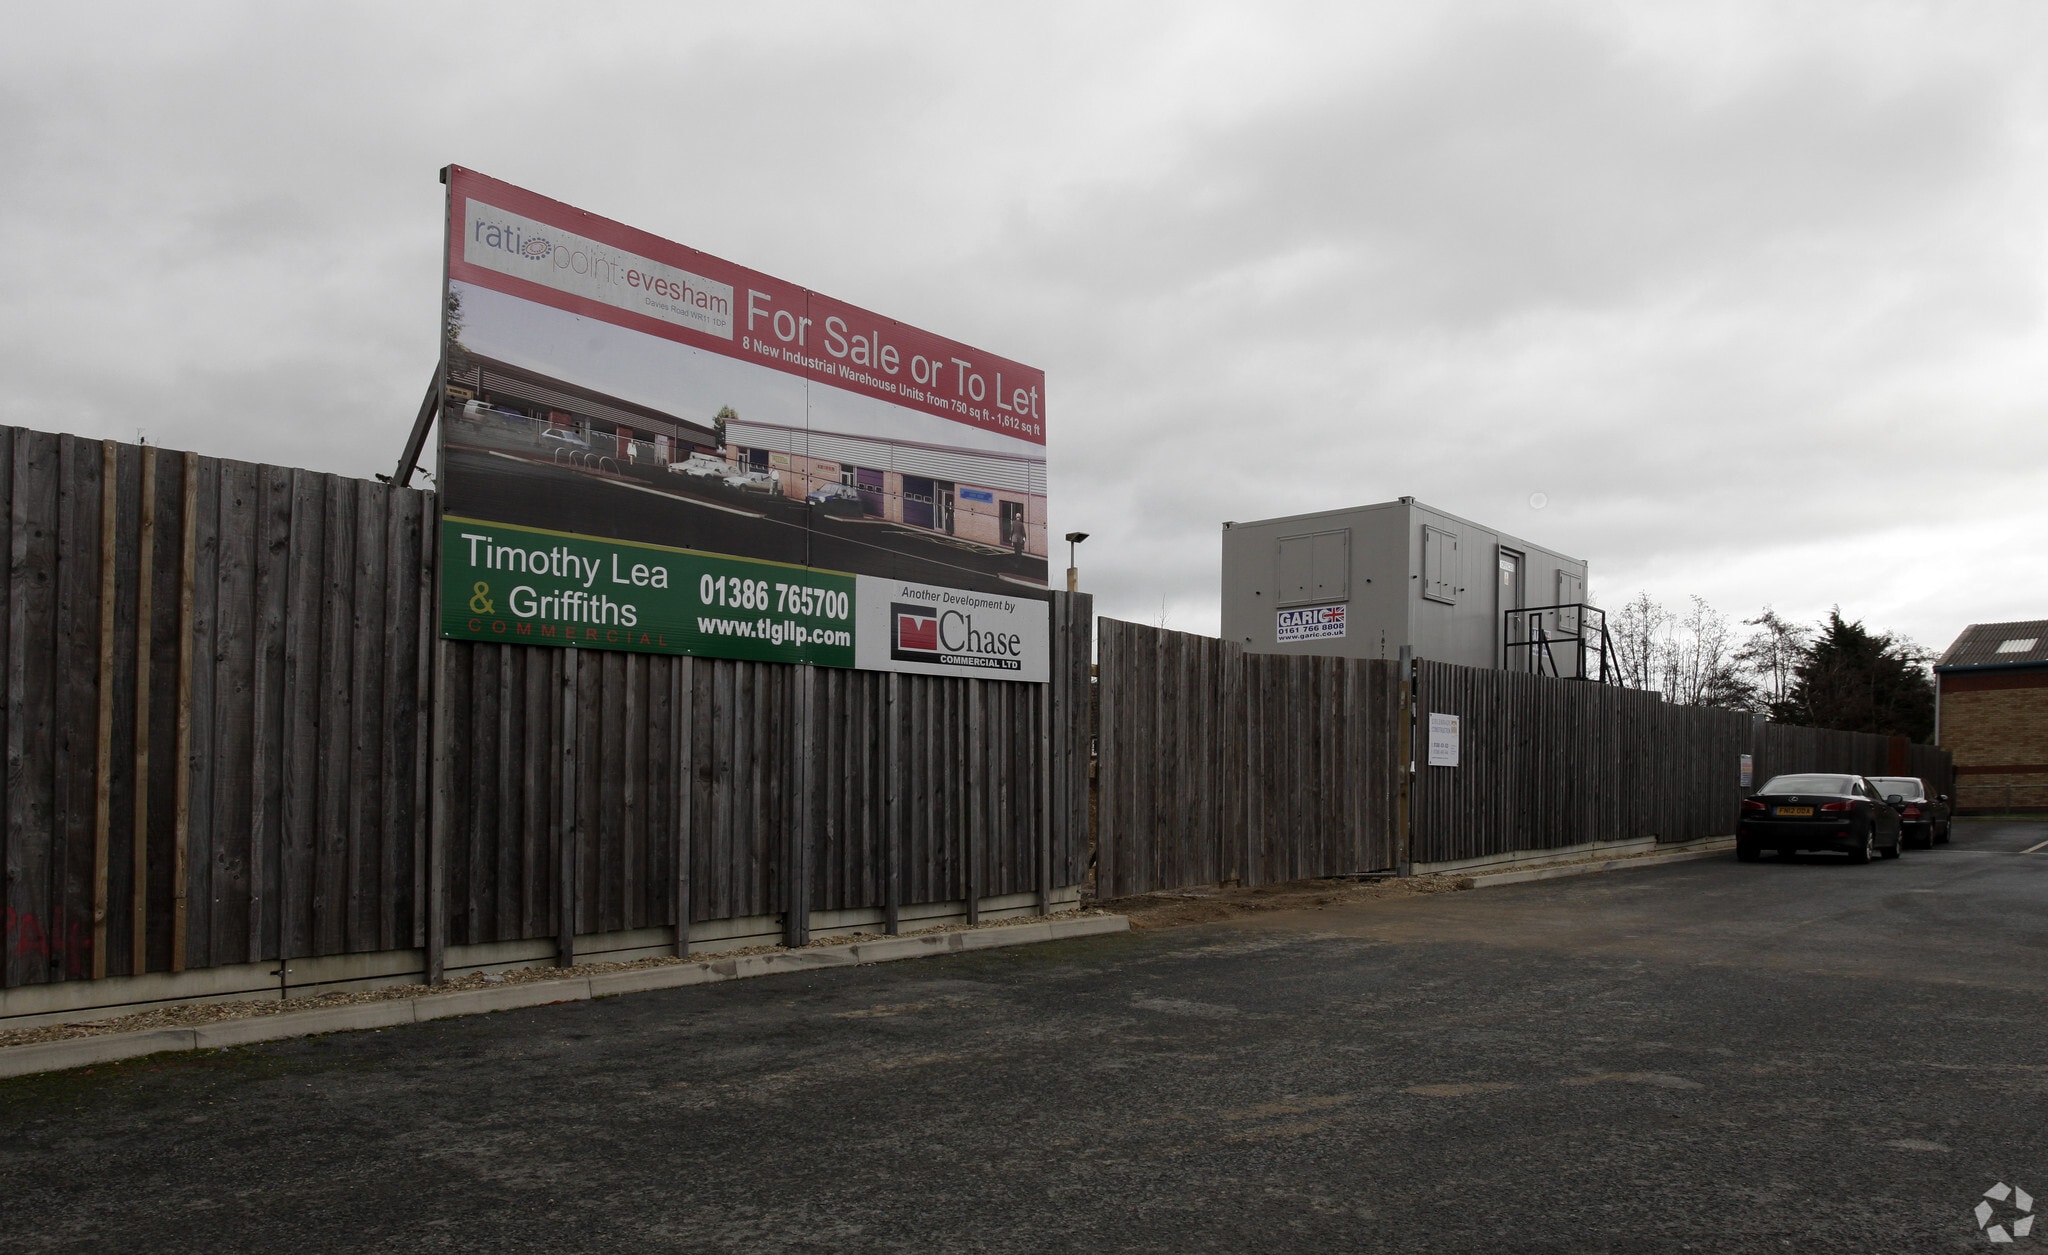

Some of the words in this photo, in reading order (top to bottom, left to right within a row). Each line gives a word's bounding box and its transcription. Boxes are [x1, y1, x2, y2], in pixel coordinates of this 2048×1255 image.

[645, 298, 670, 312] Davies
[671, 304, 689, 317] Road
[690, 309, 710, 322] WR11
[712, 317, 727, 328] 1DP
[747, 288, 812, 346] For
[824, 316, 900, 374] Sale
[911, 354, 943, 388] or
[951, 357, 986, 402] To
[996, 372, 1038, 419] Let
[742, 335, 750, 350] 8
[753, 340, 779, 358] New
[782, 346, 836, 375] Industrial
[838, 364, 897, 394] Warehouse
[899, 382, 924, 402] Units
[926, 392, 949, 409] from
[950, 399, 967, 415] 750
[969, 406, 981, 421] sq
[982, 408, 990, 422] ft
[997, 413, 1019, 430] 1,612
[1021, 421, 1032, 436] sq
[1033, 423, 1040, 436] ft
[461, 533, 600, 588] Timothy
[612, 553, 668, 589] Lea
[469, 581, 495, 615] &
[508, 585, 638, 627] Griffiths
[700, 574, 769, 610] 01386
[775, 583, 849, 620] 765700
[902, 586, 941, 603] Another
[942, 591, 1003, 611] Development
[1004, 600, 1016, 614] by
[468, 618, 668, 647] COMMERCIAL
[697, 617, 851, 647] www.tlgllp.com
[1278, 627, 1299, 635] 0161
[1280, 609, 1332, 626] GARIC
[939, 610, 1021, 656] Chase
[1278, 630, 1344, 641] www.garic.co.uk
[940, 655, 1000, 668] COMMERCIAL
[1001, 660, 1018, 669] LTD
